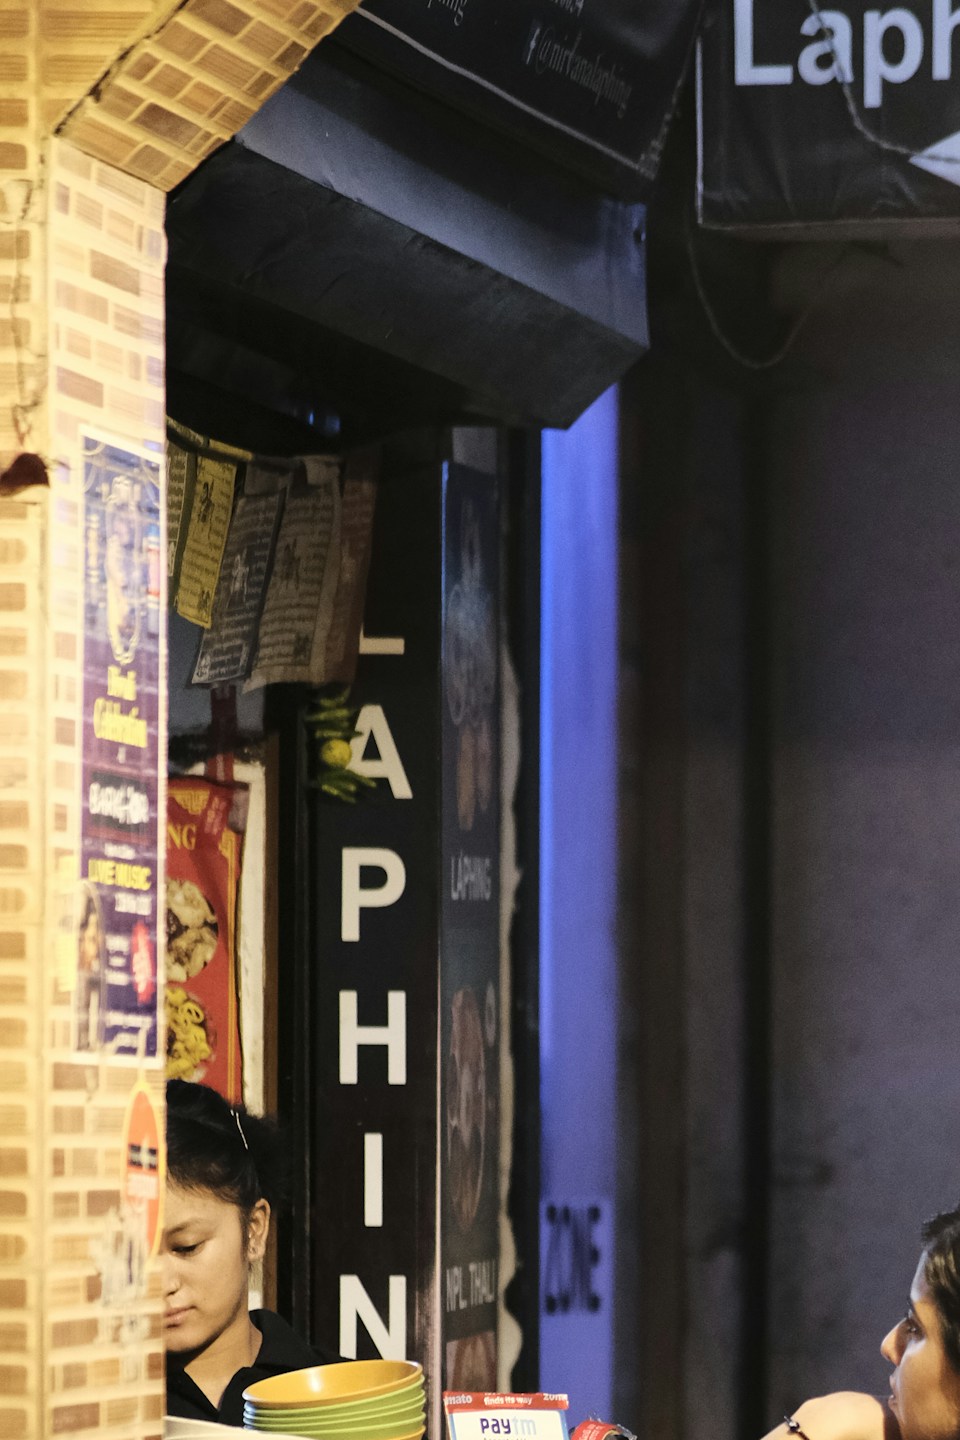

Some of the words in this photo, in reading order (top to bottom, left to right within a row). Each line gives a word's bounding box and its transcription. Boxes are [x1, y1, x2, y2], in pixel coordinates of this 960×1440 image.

[484, 1396, 504, 1406] finds
[505, 1396, 516, 1405] its
[516, 1396, 533, 1406] way
[480, 1416, 537, 1435] paytm
